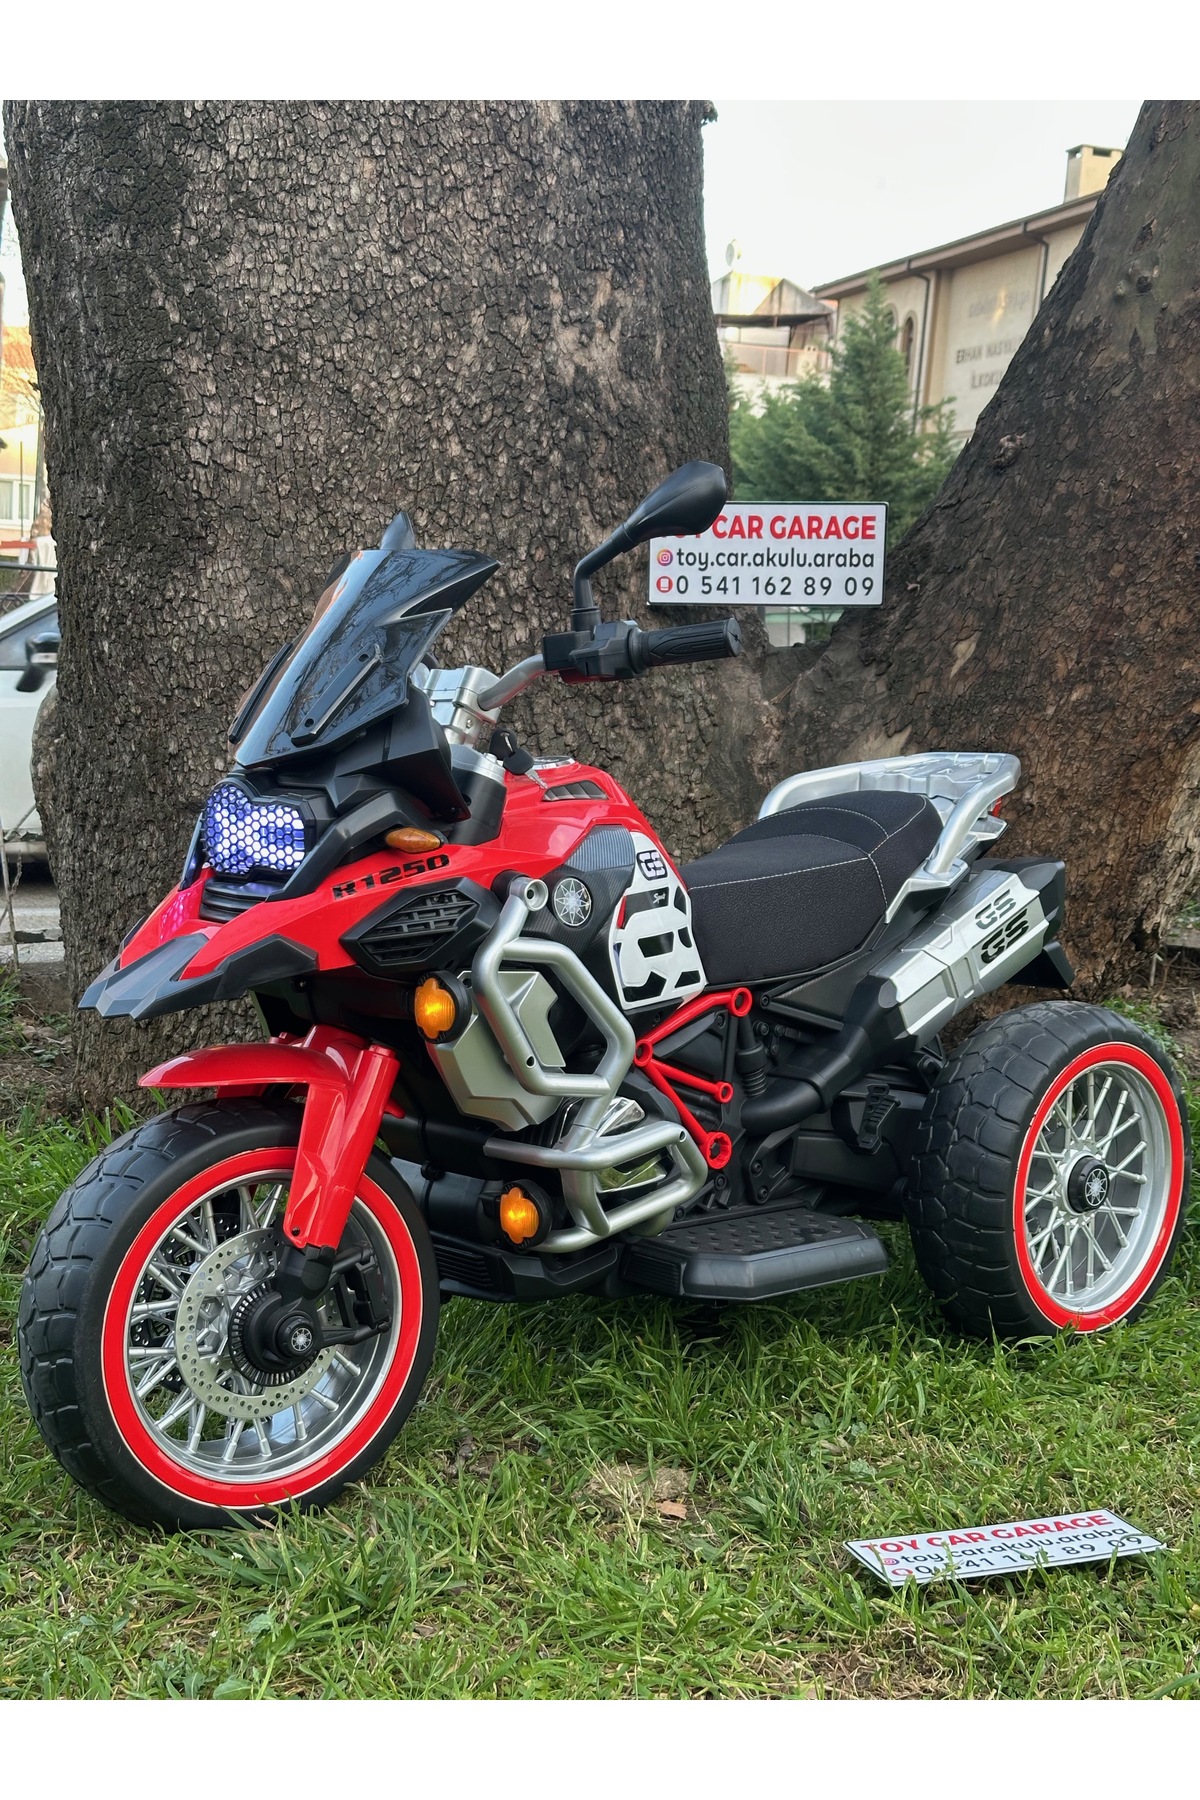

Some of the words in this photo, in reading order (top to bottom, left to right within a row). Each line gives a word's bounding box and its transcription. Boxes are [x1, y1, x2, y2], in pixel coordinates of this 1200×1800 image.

[712, 515, 764, 539] CAR
[769, 515, 877, 540] GARAGE
[677, 547, 875, 571] toy.car.akulu.araba
[676, 575, 689, 594] 0
[701, 576, 740, 595] 541
[752, 576, 792, 596] 162
[804, 576, 832, 596] 89
[844, 577, 874, 596] 09
[331, 854, 450, 900] R1250
[975, 889, 1016, 930] GS
[981, 908, 1029, 964] GS
[860, 1539, 920, 1552] TOY
[927, 1532, 991, 1547] CAR
[991, 1514, 1114, 1539] GARAGE
[945, 1557, 995, 1570] 41
[1062, 1543, 1095, 1555] 89
[1108, 1536, 1142, 1548] 09
